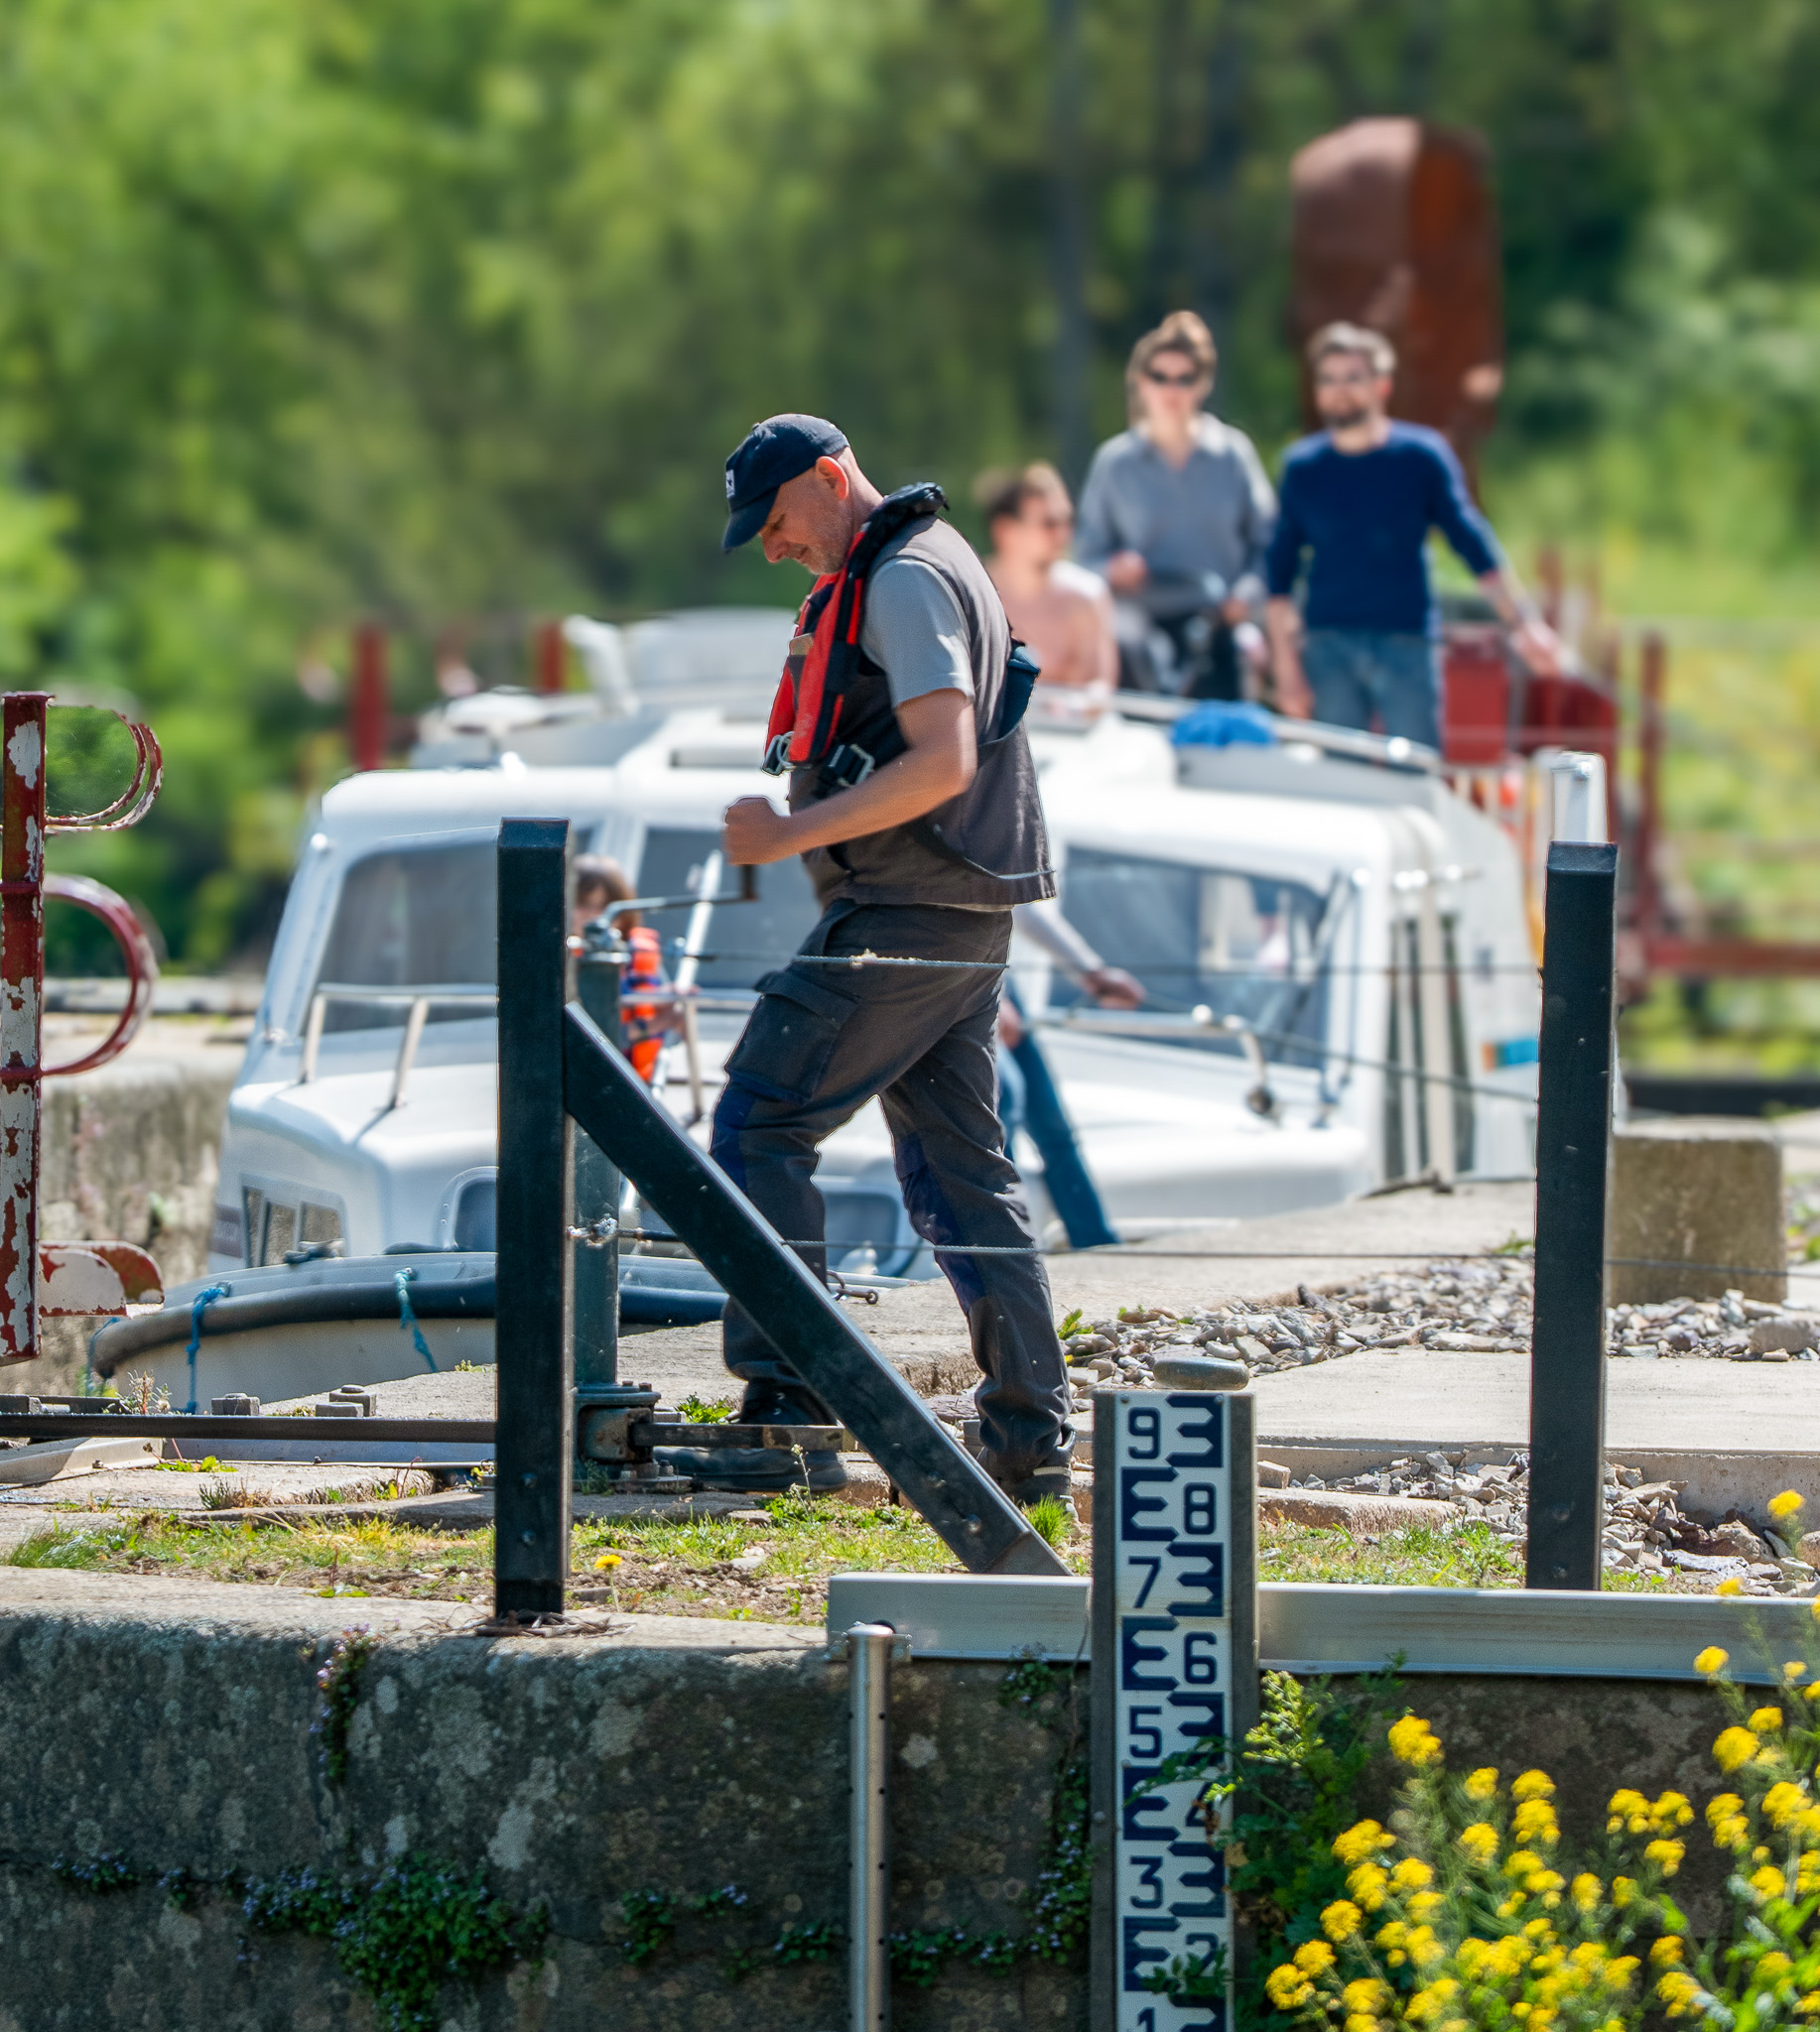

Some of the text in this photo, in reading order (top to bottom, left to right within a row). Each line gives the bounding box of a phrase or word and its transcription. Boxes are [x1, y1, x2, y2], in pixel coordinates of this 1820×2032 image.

[1128, 1407, 1160, 1460] 9
[1184, 1481, 1217, 1535] 8
[1128, 1556, 1161, 1609] 7
[1184, 1631, 1217, 1684] 6
[1129, 1706, 1162, 1758] 5
[1130, 1855, 1163, 1909] 3
